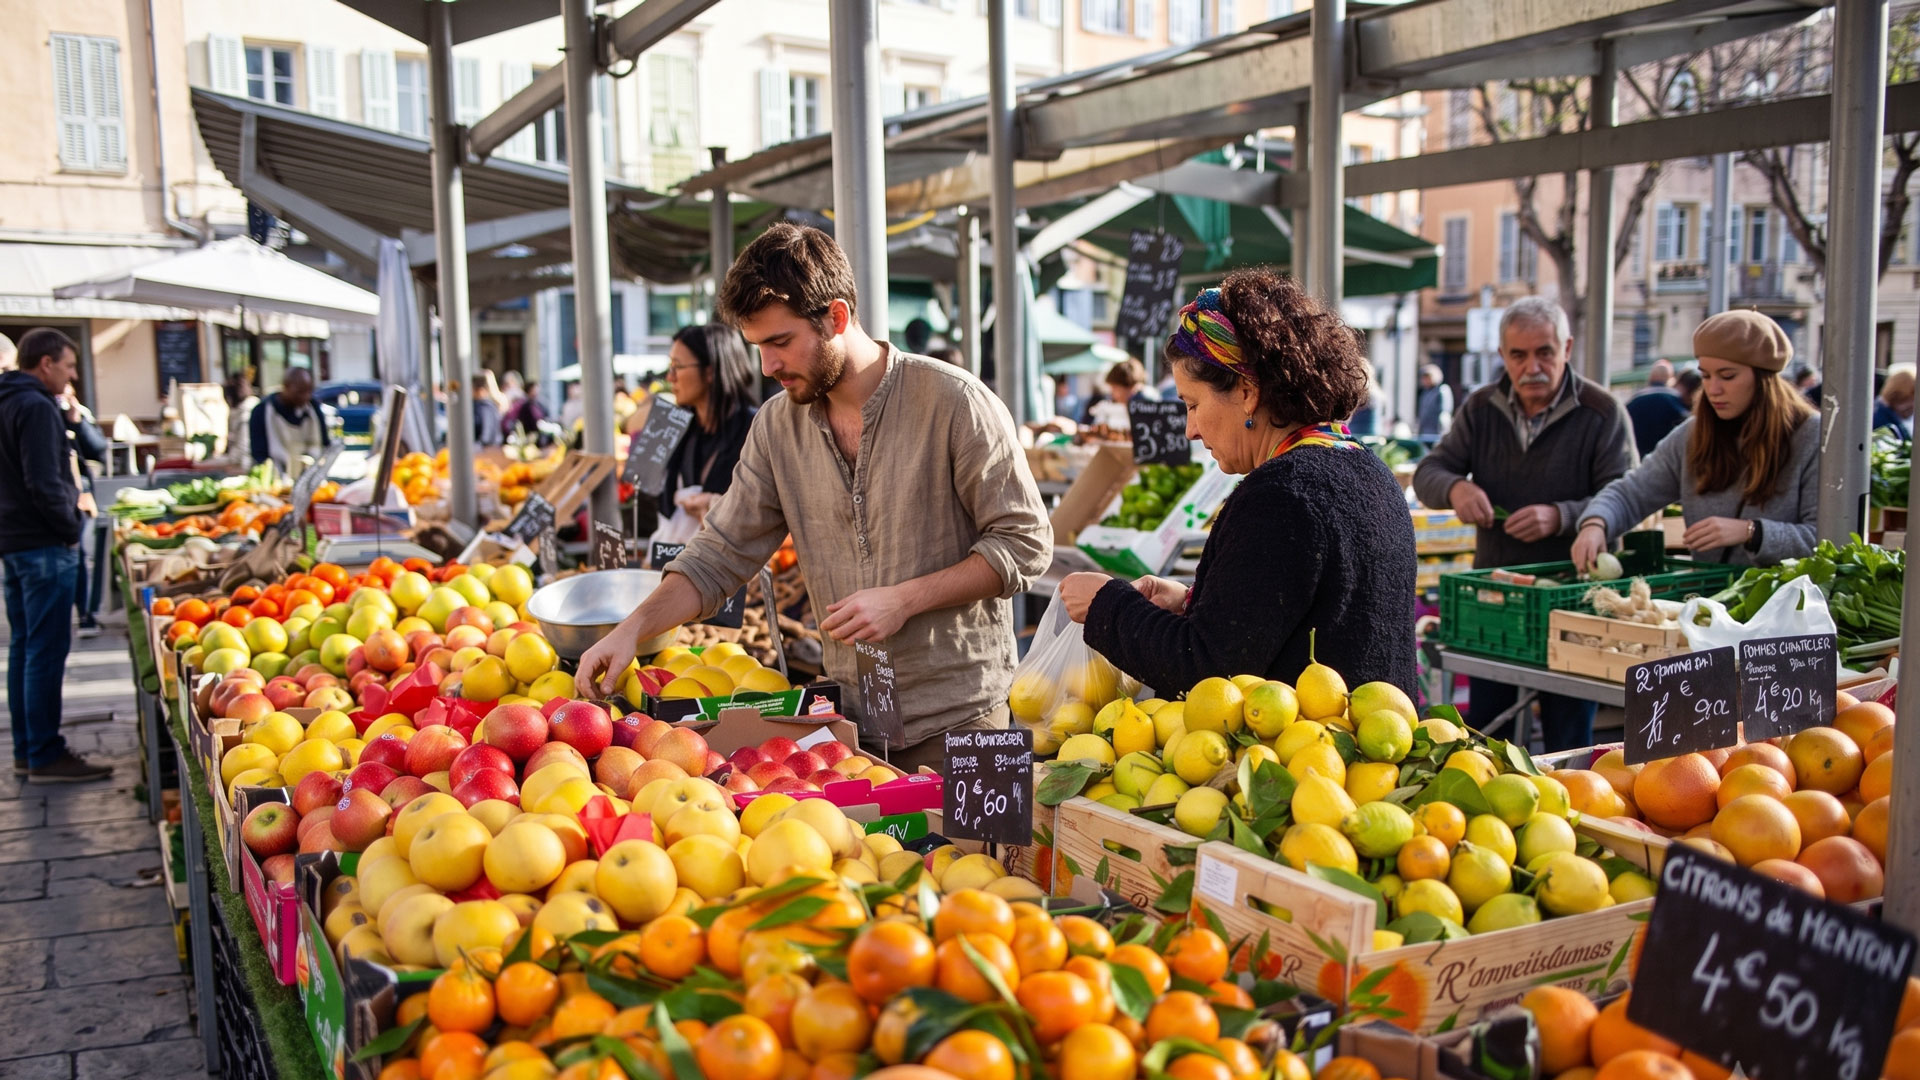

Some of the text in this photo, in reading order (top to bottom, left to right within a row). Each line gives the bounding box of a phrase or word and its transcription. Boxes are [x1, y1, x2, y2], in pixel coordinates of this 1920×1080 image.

[1764, 900, 1794, 935] de
[1799, 909, 1911, 983] MENTON
[1827, 1015, 1865, 1080] Kg
